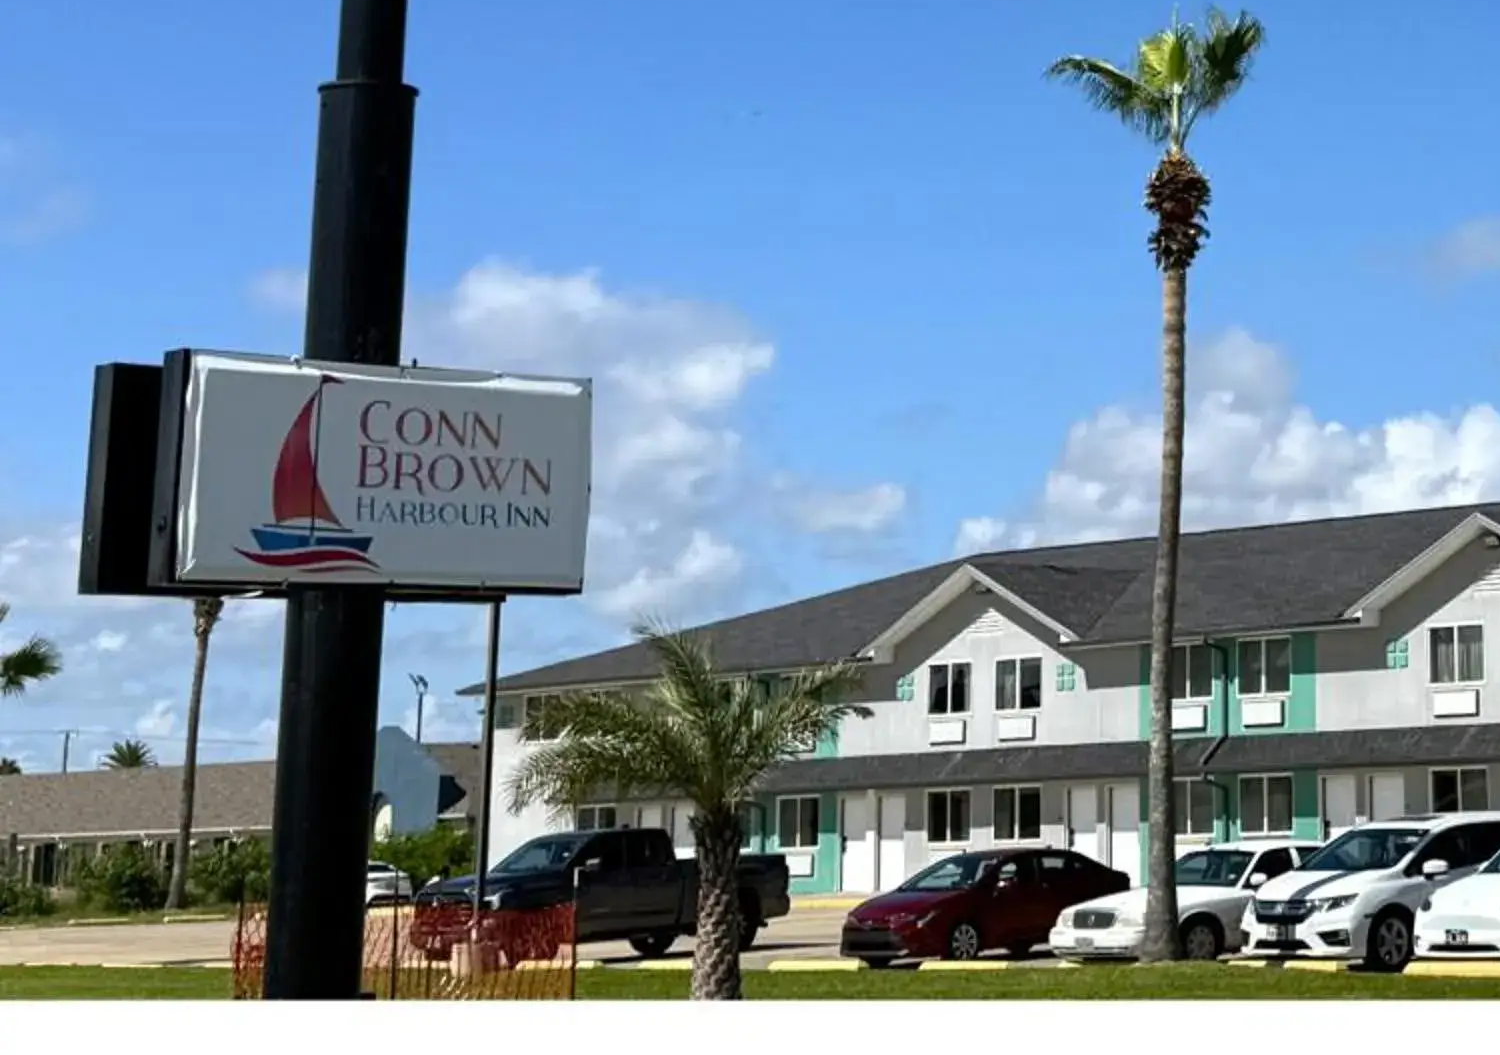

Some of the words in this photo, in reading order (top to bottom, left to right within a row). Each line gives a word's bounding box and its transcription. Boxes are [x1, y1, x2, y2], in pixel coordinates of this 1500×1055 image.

[358, 399, 503, 448] CONN
[356, 444, 552, 496] BROWN
[356, 495, 499, 529] HARBOUR
[505, 501, 552, 528] INN
